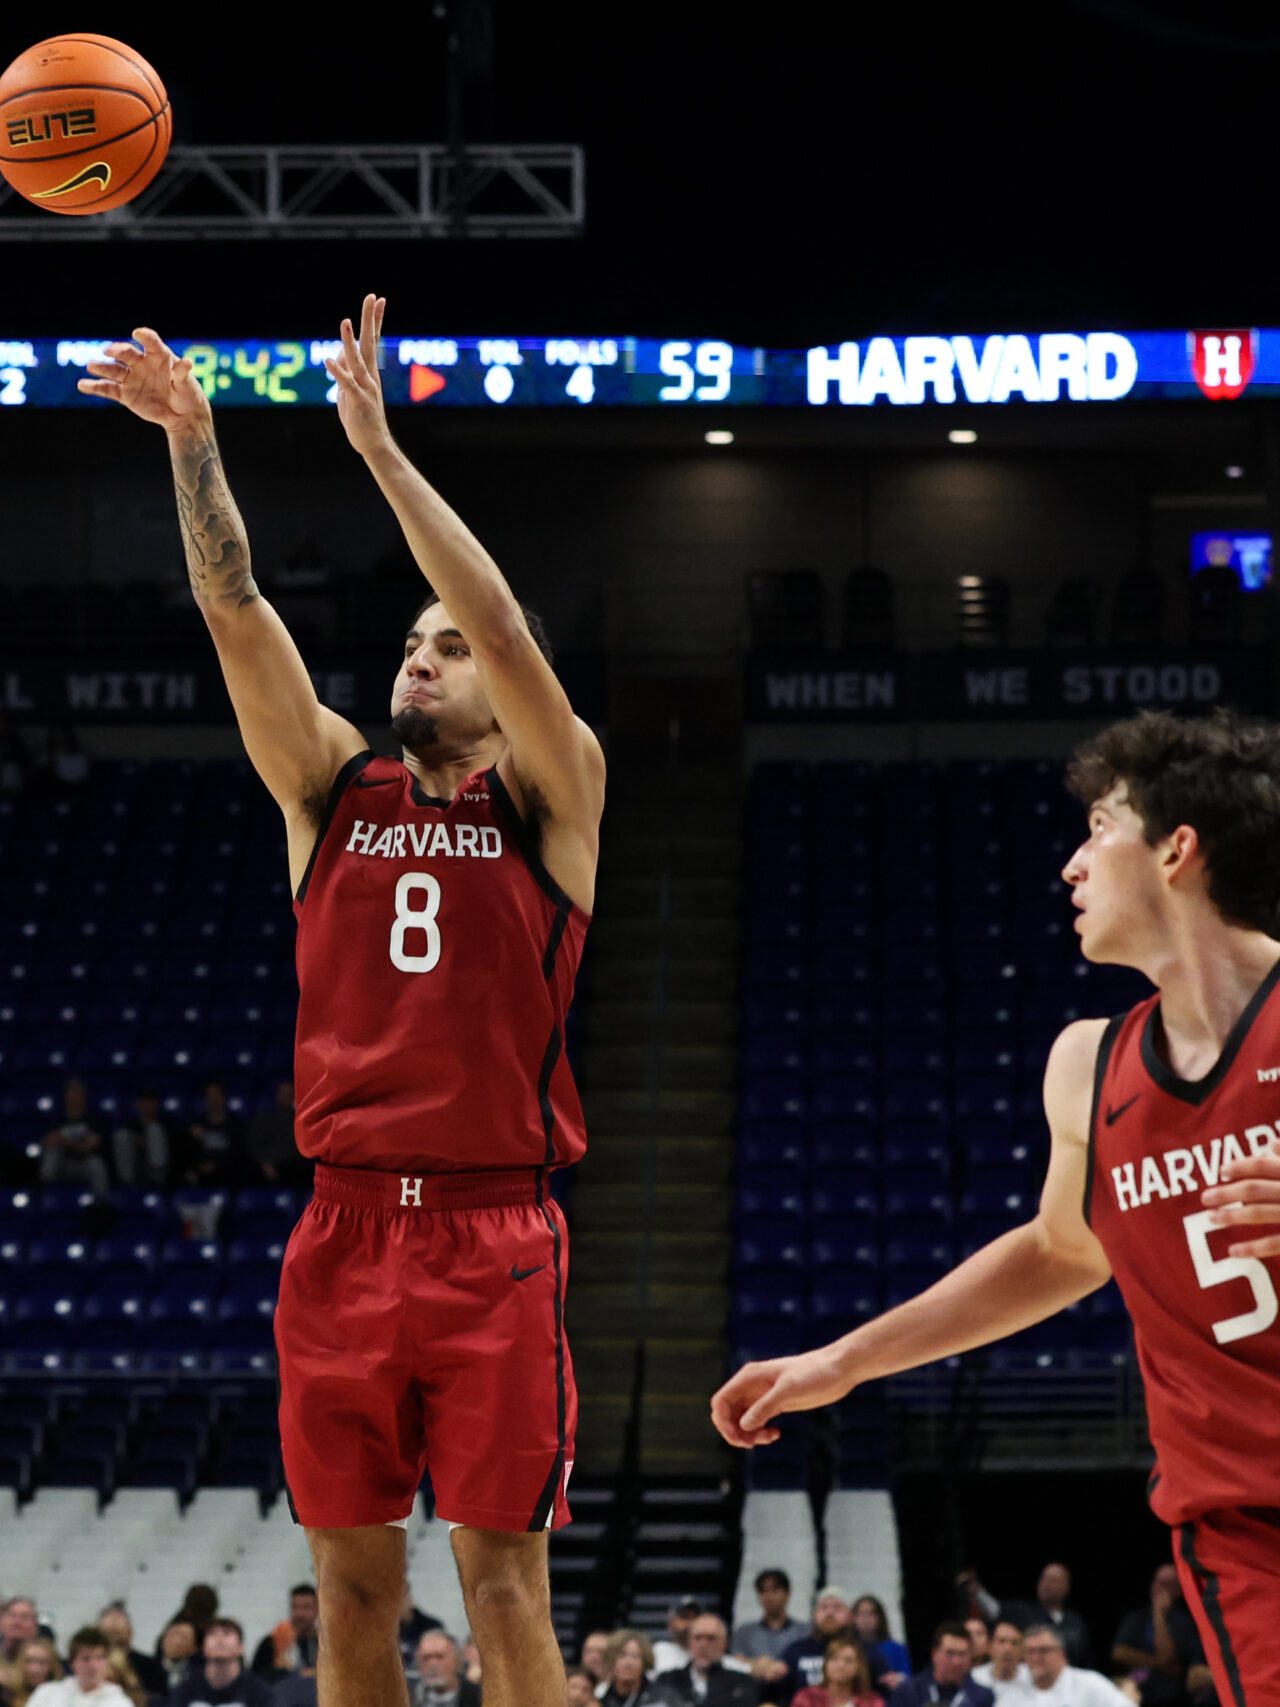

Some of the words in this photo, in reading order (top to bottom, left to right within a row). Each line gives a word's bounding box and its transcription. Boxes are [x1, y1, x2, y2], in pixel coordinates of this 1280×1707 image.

[7, 108, 97, 147] ELITE
[484, 364, 514, 404] 0
[565, 364, 595, 404] 4
[659, 342, 733, 402] 59
[807, 332, 1138, 405] HARVARD
[1203, 336, 1242, 387] H
[66, 671, 198, 710] WITH
[766, 671, 897, 709] WHEN
[965, 667, 1031, 705] WE
[1062, 663, 1221, 704] STOOD
[346, 820, 502, 858] HARVARD
[389, 872, 441, 973] 8
[1111, 1119, 1280, 1212] HARVAR
[400, 1177, 422, 1206] H
[1183, 1201, 1279, 1344] 5
